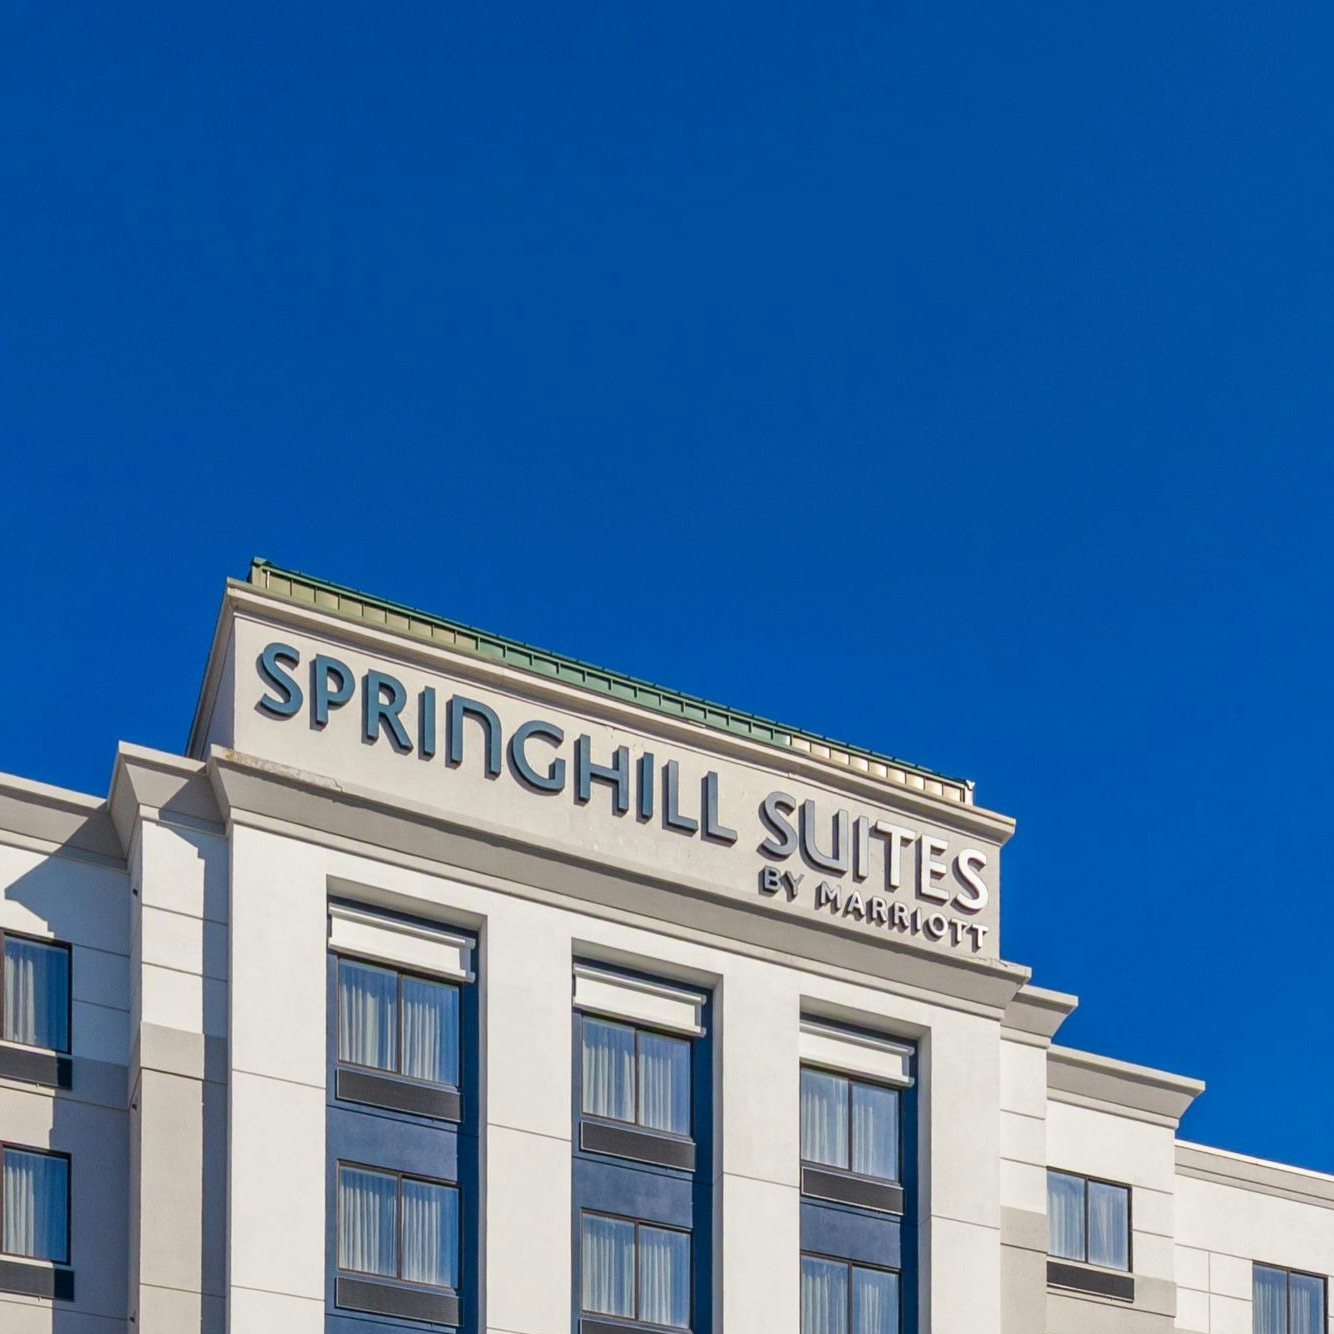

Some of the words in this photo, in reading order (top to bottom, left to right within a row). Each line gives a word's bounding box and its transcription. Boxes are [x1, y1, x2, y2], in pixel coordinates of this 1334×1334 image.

[258, 641, 738, 844] SPRINGHILL
[759, 790, 989, 915] SUITES
[759, 865, 805, 902] BY
[815, 881, 989, 952] MARRIOTT
